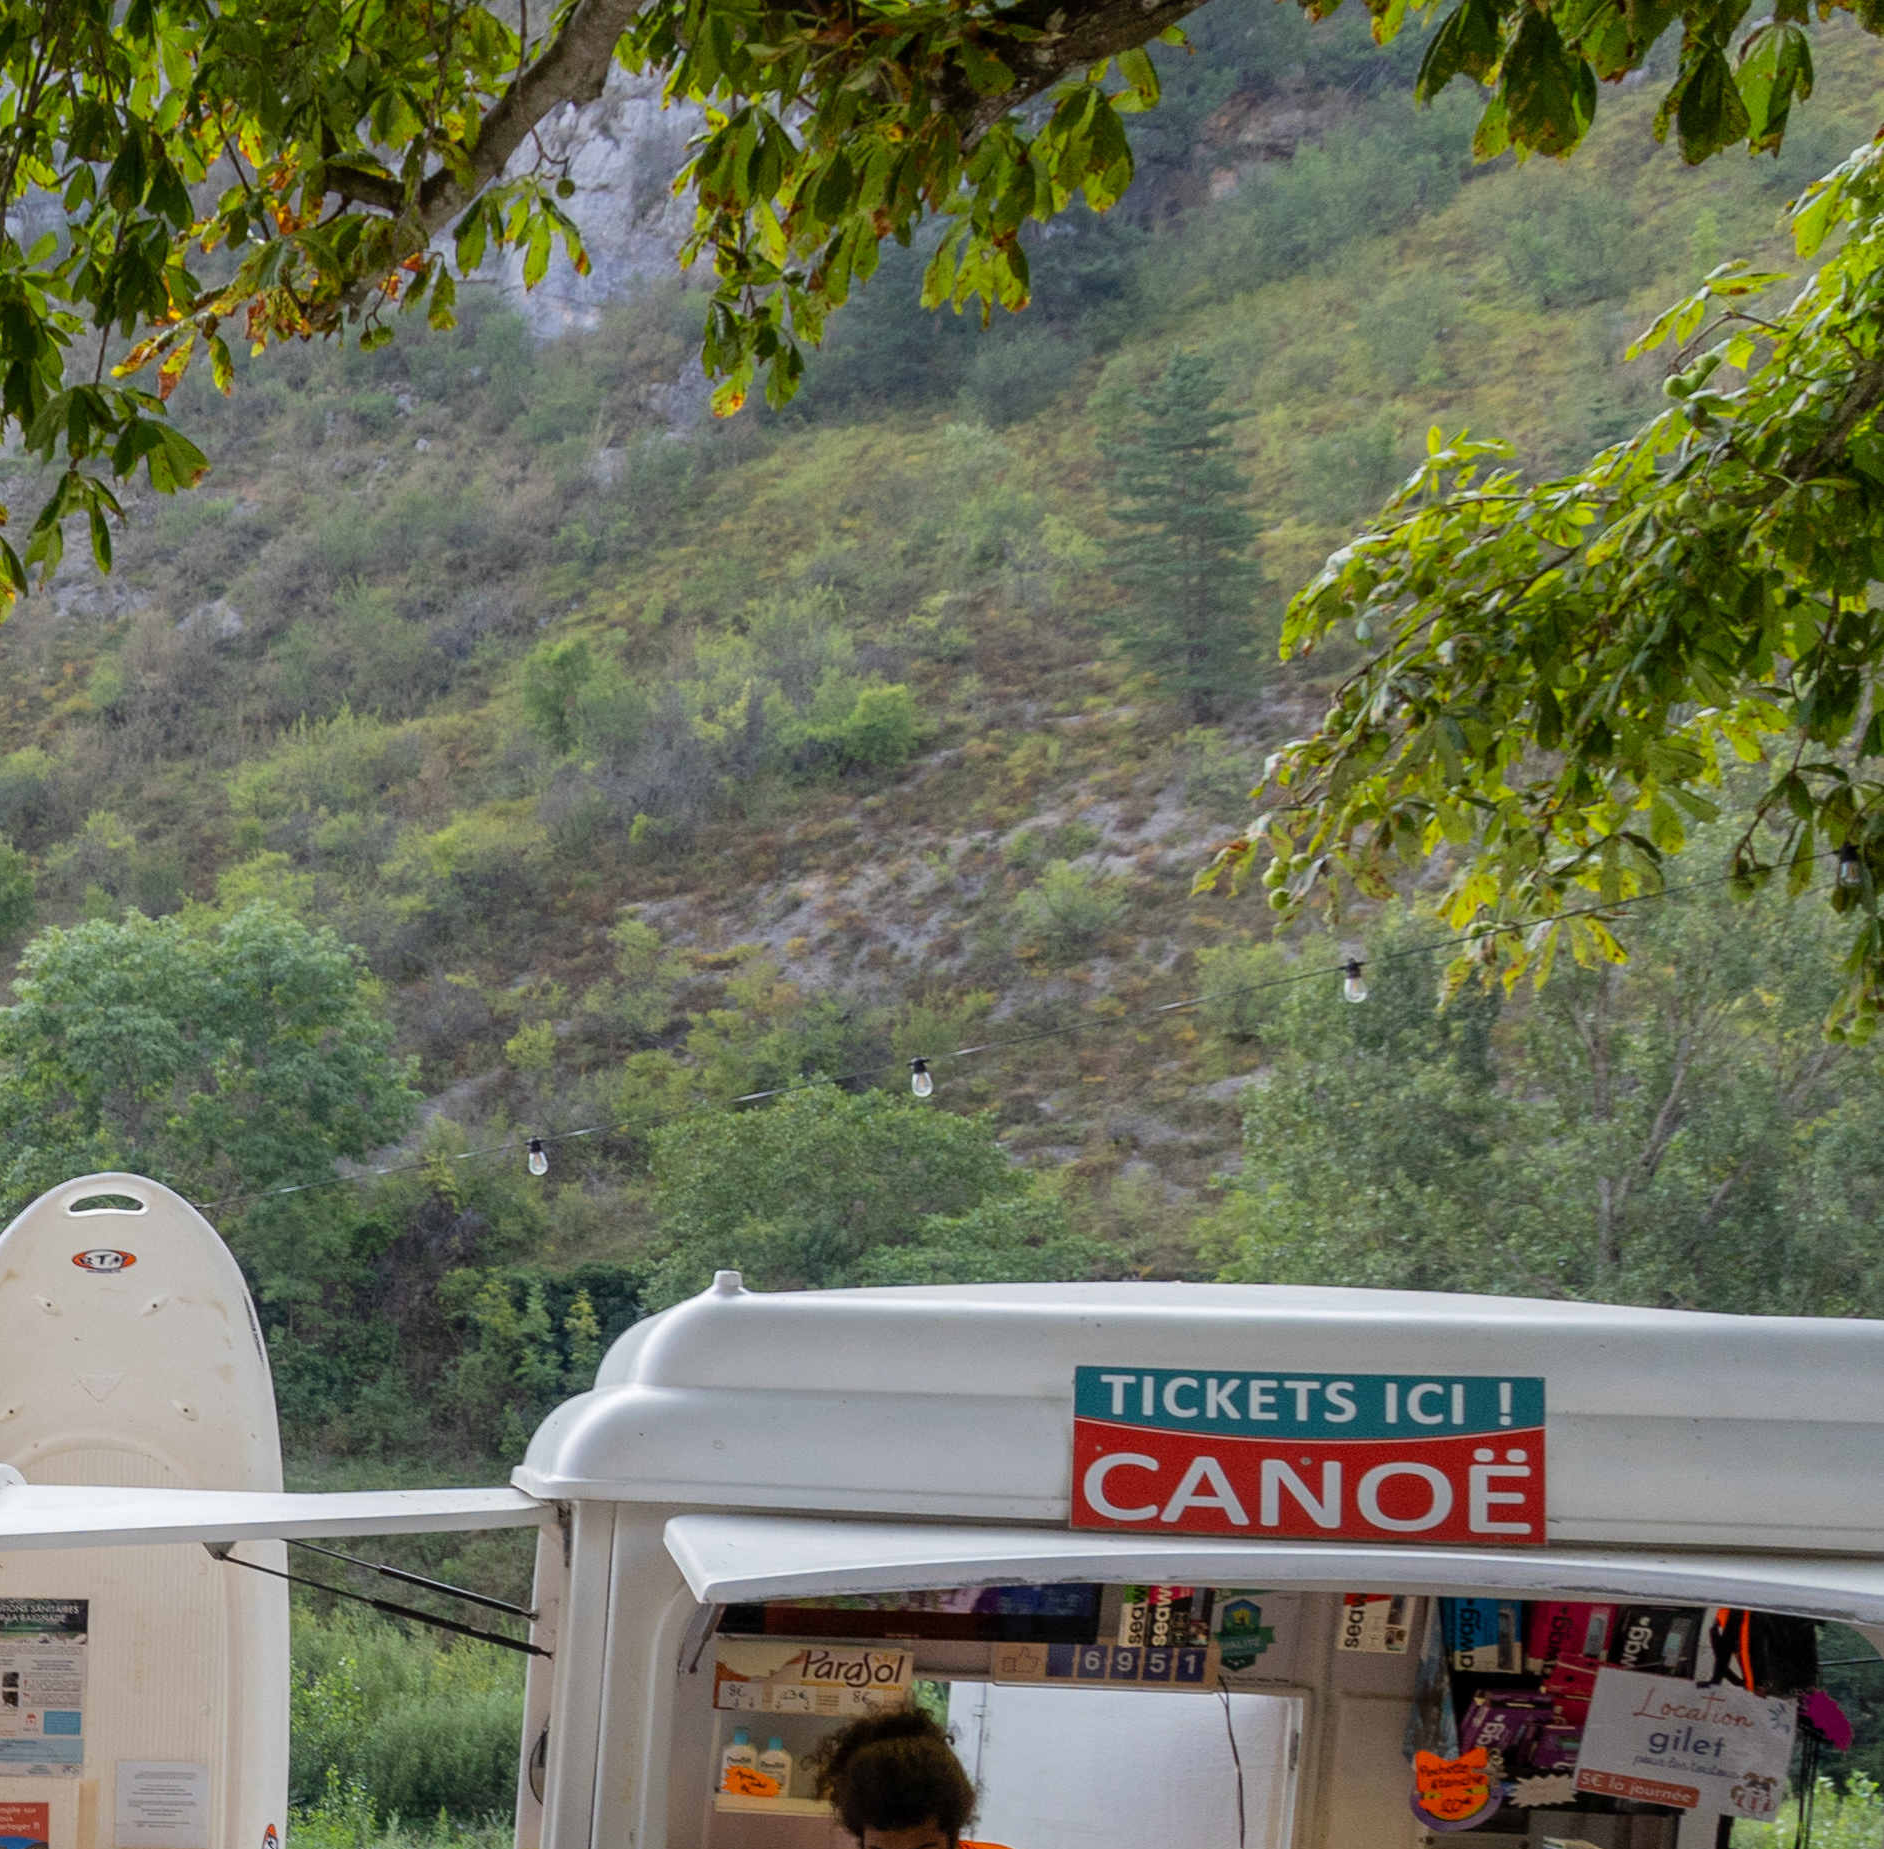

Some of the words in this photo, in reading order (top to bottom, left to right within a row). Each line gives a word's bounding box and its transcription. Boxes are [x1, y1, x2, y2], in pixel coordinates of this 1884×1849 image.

[1100, 1374, 1357, 1423] TICKETS
[1385, 1382, 1465, 1425] ICI
[1498, 1382, 1513, 1426] !
[1083, 1447, 1532, 1535] CANOË
[1632, 1686, 1754, 1728] Location
[1649, 1726, 1727, 1758] gilet
[1580, 1772, 1603, 1788] 5€
[1607, 1775, 1625, 1792] la
[1628, 1782, 1692, 1803] journée
